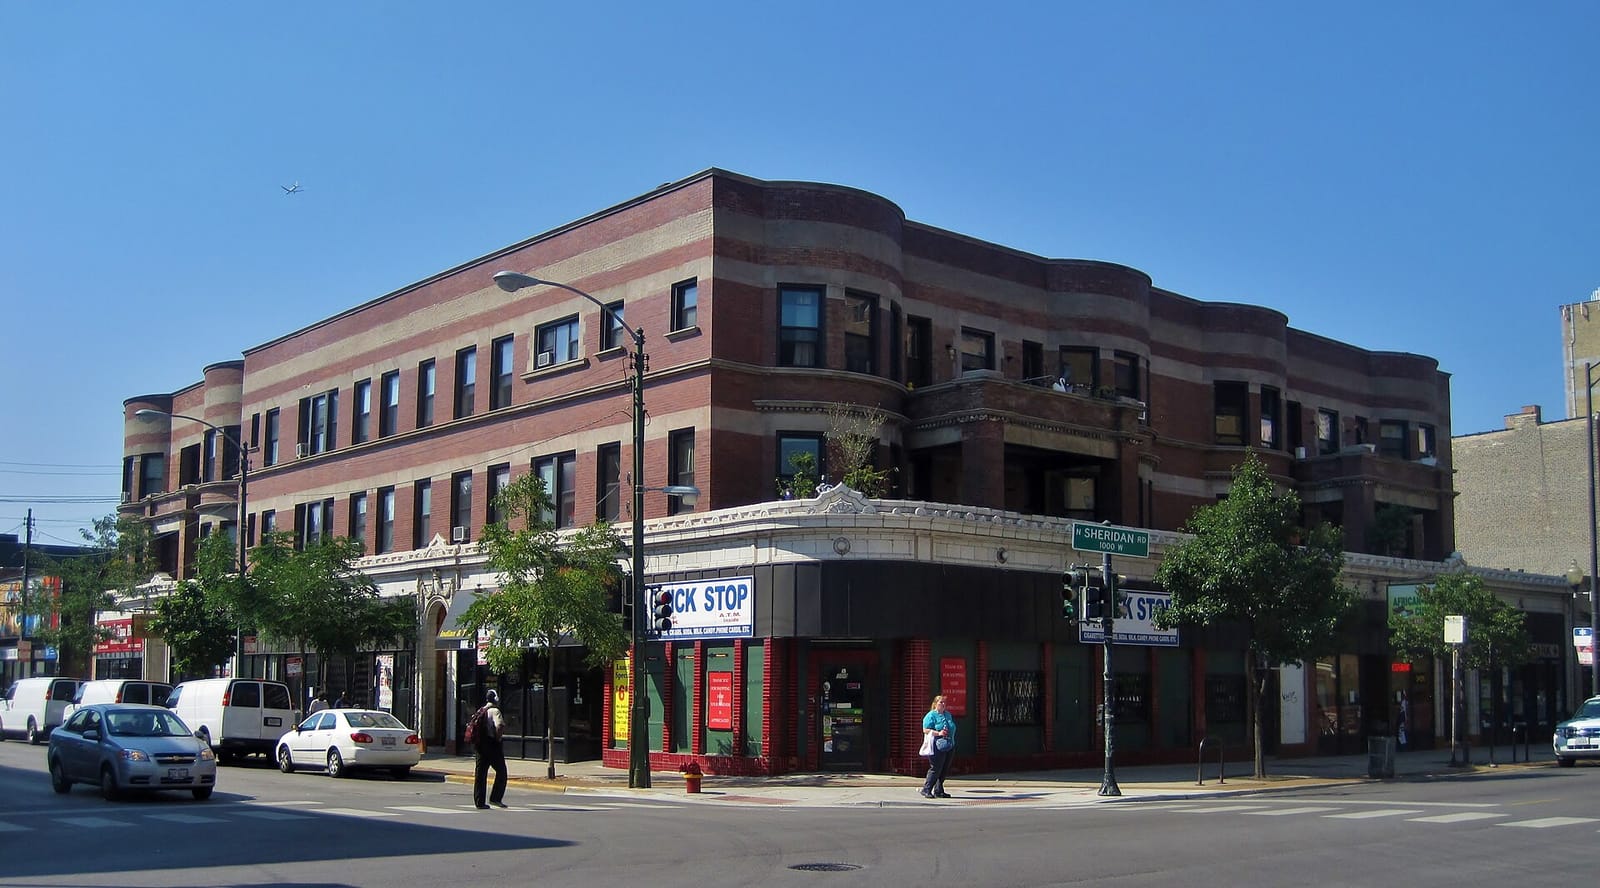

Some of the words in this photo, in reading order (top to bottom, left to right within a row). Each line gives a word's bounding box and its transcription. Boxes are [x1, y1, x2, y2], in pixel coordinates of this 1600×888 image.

[1076, 528, 1081, 536] N
[1084, 527, 1134, 544] SHERIDAN
[1137, 536, 1147, 544] RD
[1099, 541, 1115, 551] 1000
[1117, 543, 1124, 552] W
[704, 584, 748, 612] STOP
